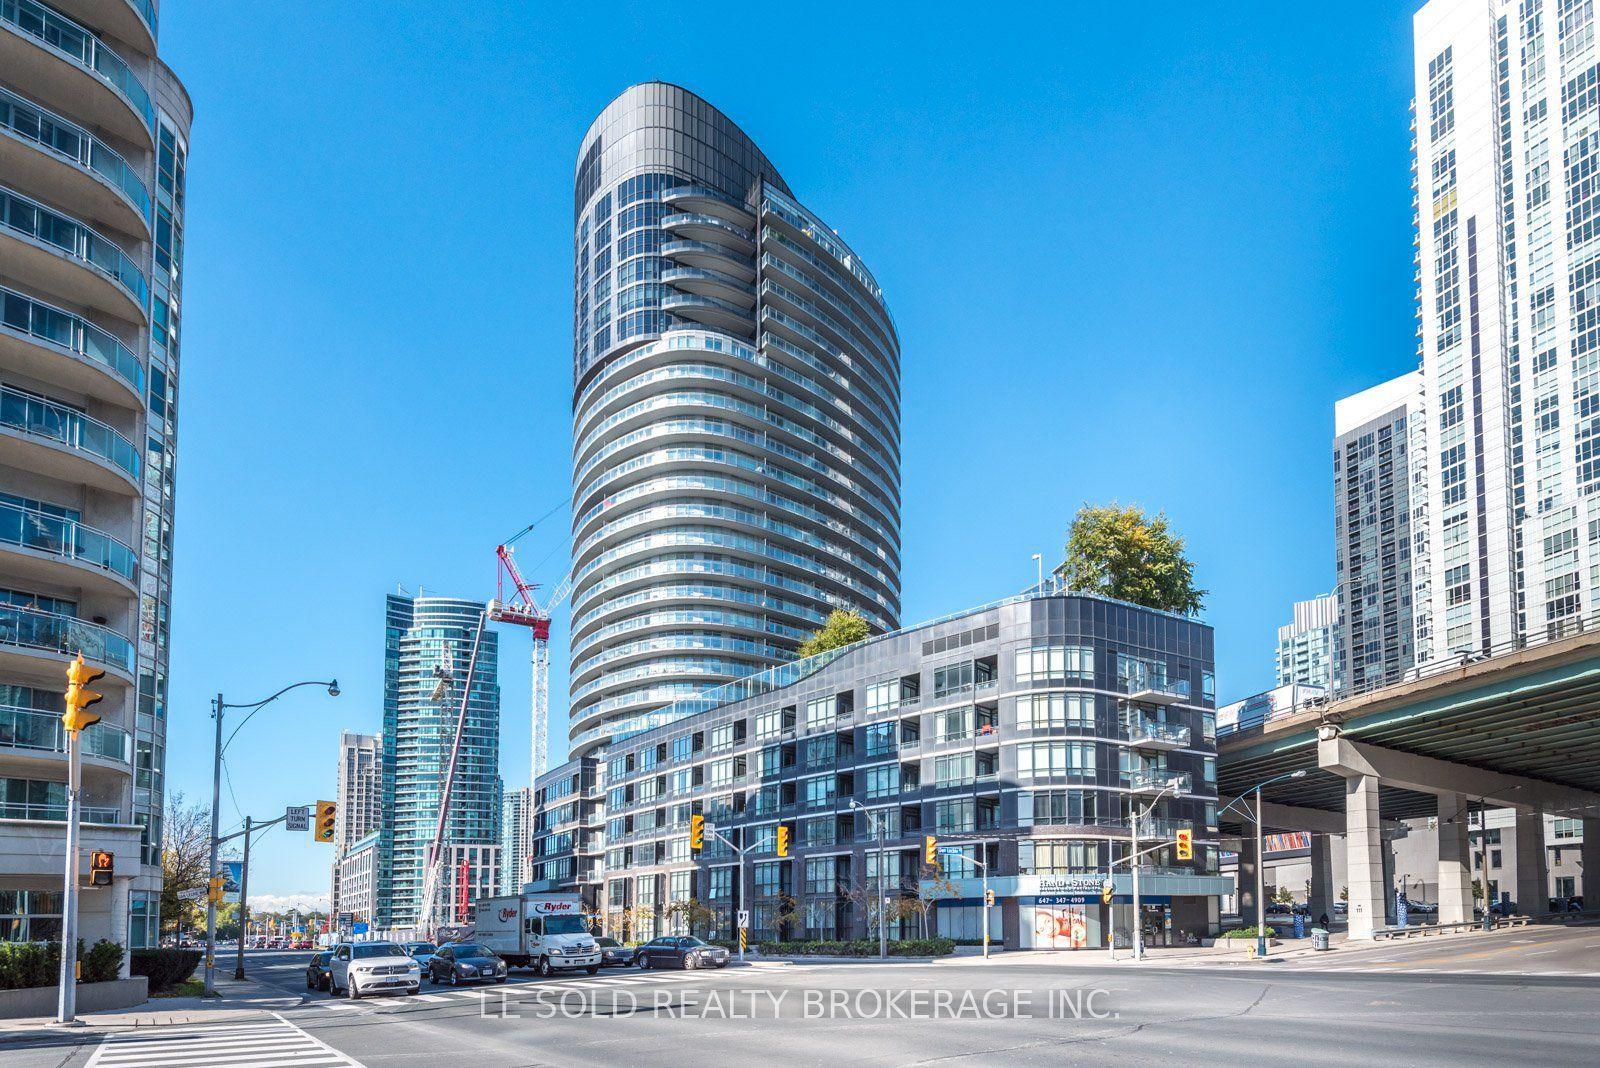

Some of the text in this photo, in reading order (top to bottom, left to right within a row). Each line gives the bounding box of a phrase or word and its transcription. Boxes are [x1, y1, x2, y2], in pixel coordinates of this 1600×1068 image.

[1039, 879, 1064, 888] HAND
[1072, 879, 1101, 888] STONE
[544, 902, 572, 912] Ryder
[502, 906, 518, 919] Ryder
